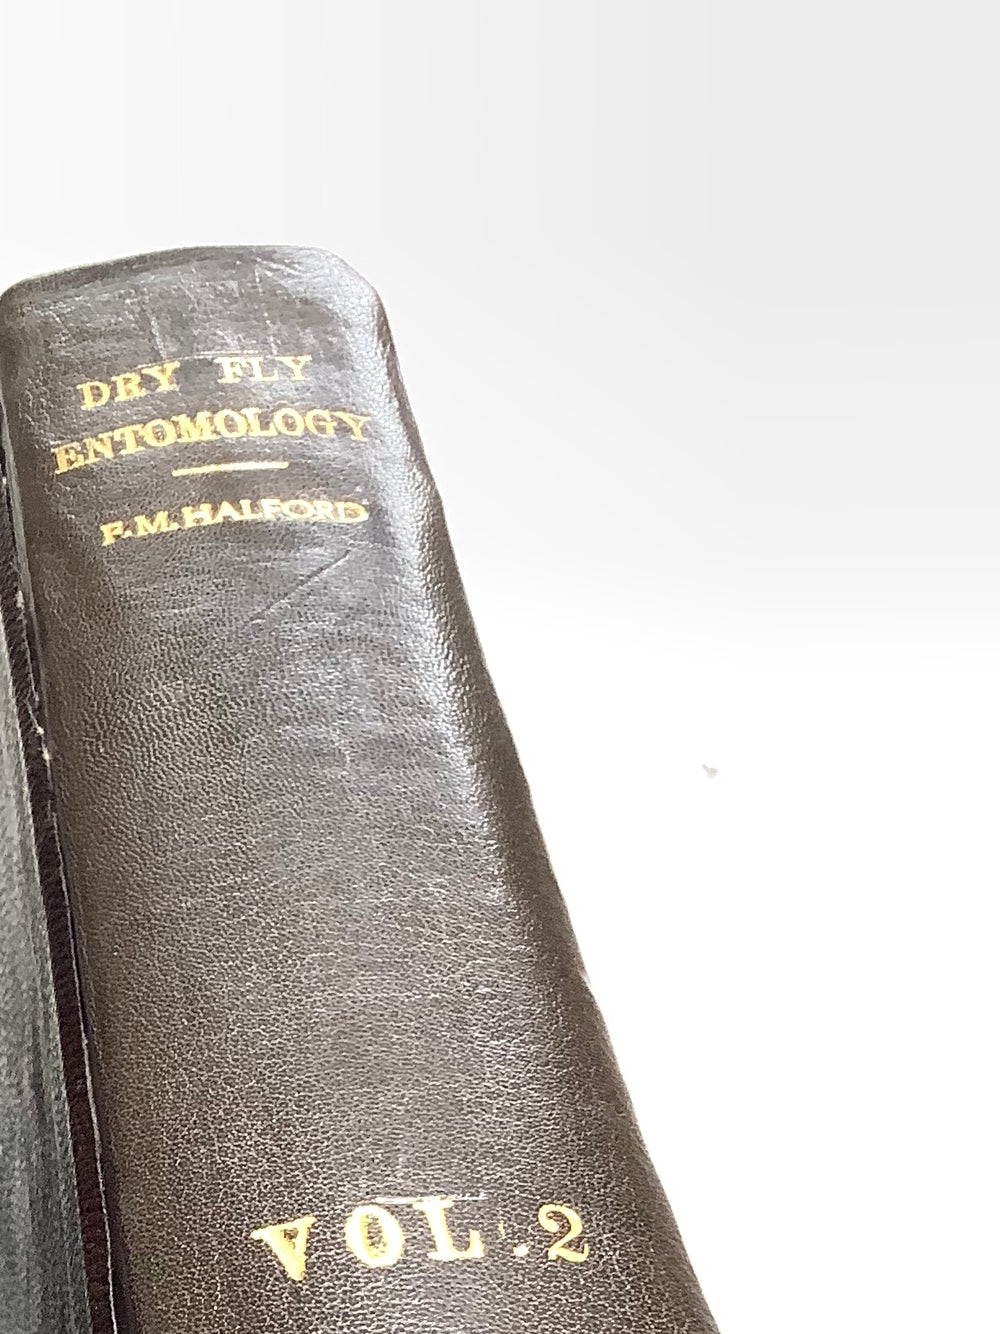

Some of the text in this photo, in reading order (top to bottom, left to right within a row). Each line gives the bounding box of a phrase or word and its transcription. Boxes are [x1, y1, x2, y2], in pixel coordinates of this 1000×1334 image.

[76, 354, 312, 411] DRY FLY
[53, 406, 371, 474] ENTOMOLOGY
